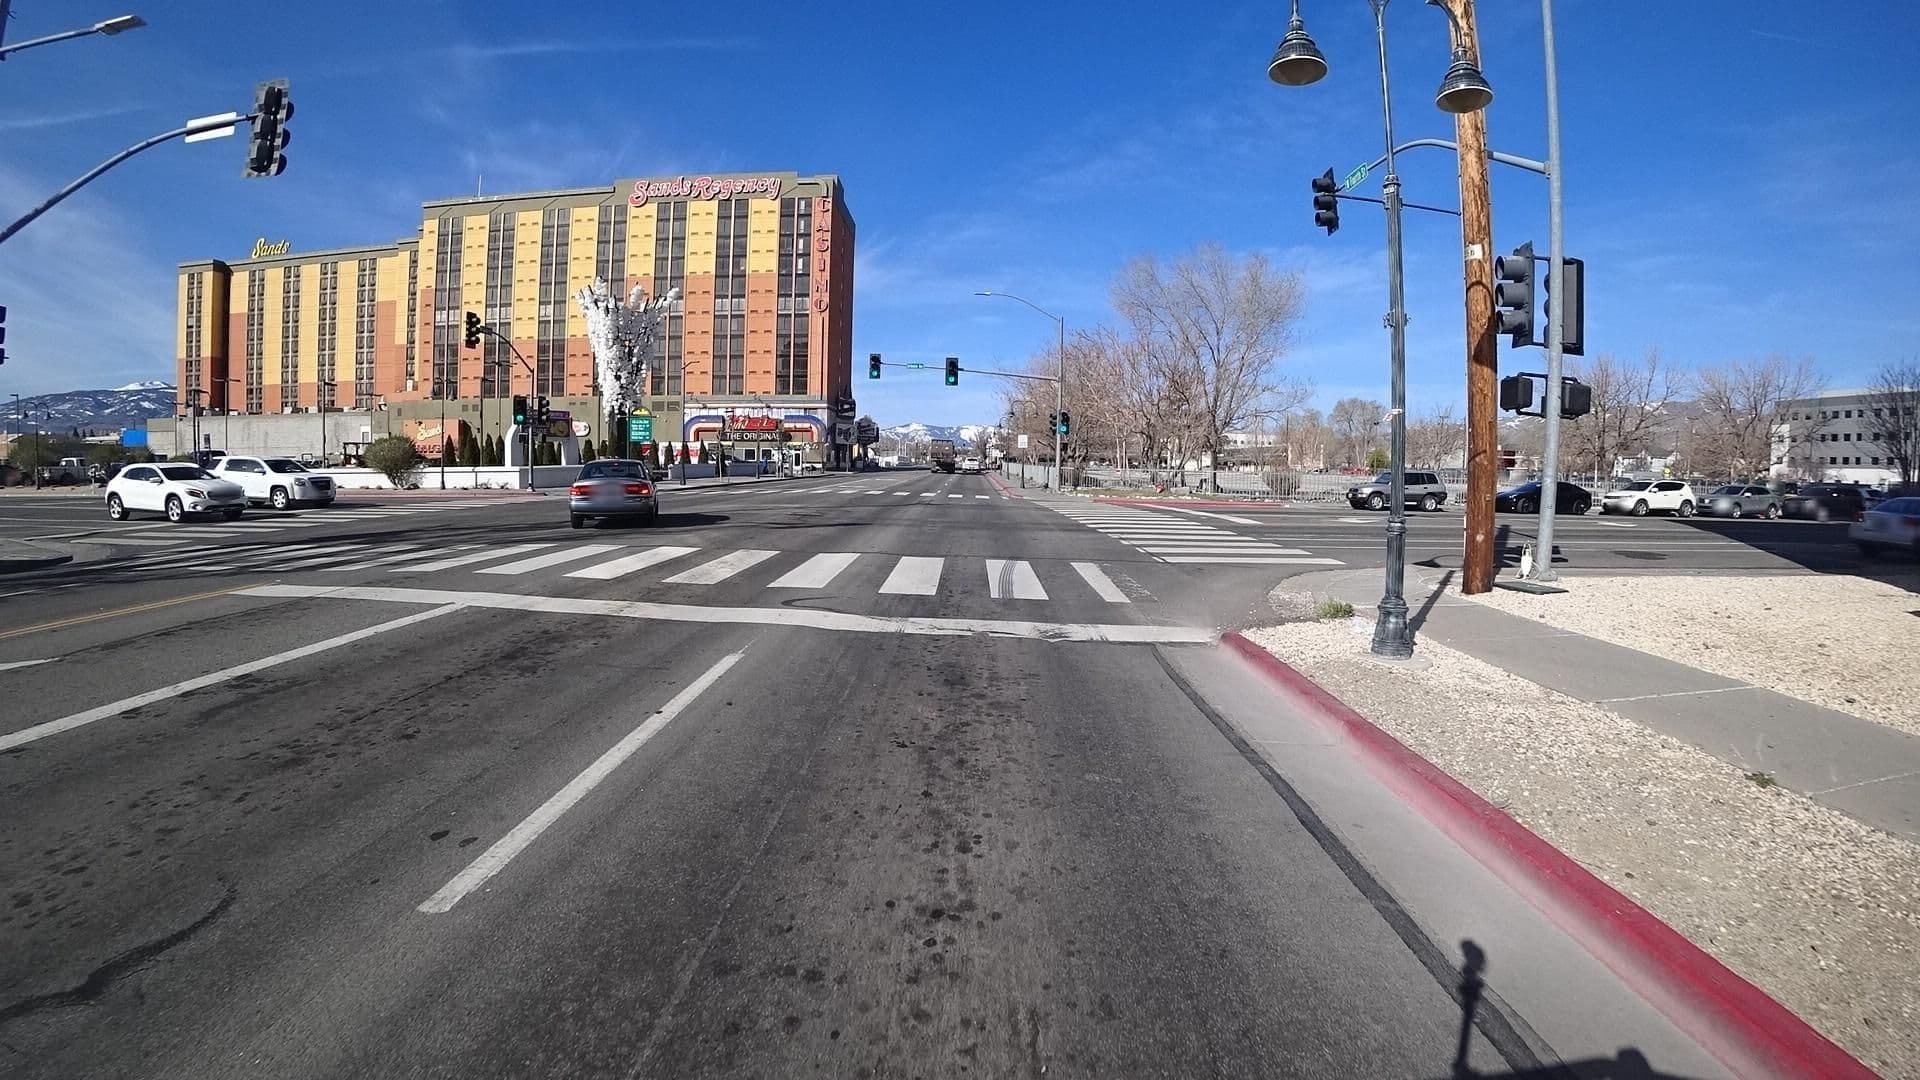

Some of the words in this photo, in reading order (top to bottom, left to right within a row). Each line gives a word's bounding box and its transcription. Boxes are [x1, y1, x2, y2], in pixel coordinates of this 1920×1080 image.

[629, 176, 690, 207] Sands
[692, 176, 781, 200] Regency
[252, 237, 290, 259] Sands
[814, 198, 830, 313] CASINO
[726, 432, 742, 440] THE
[743, 432, 780, 440] ORIGINAL
